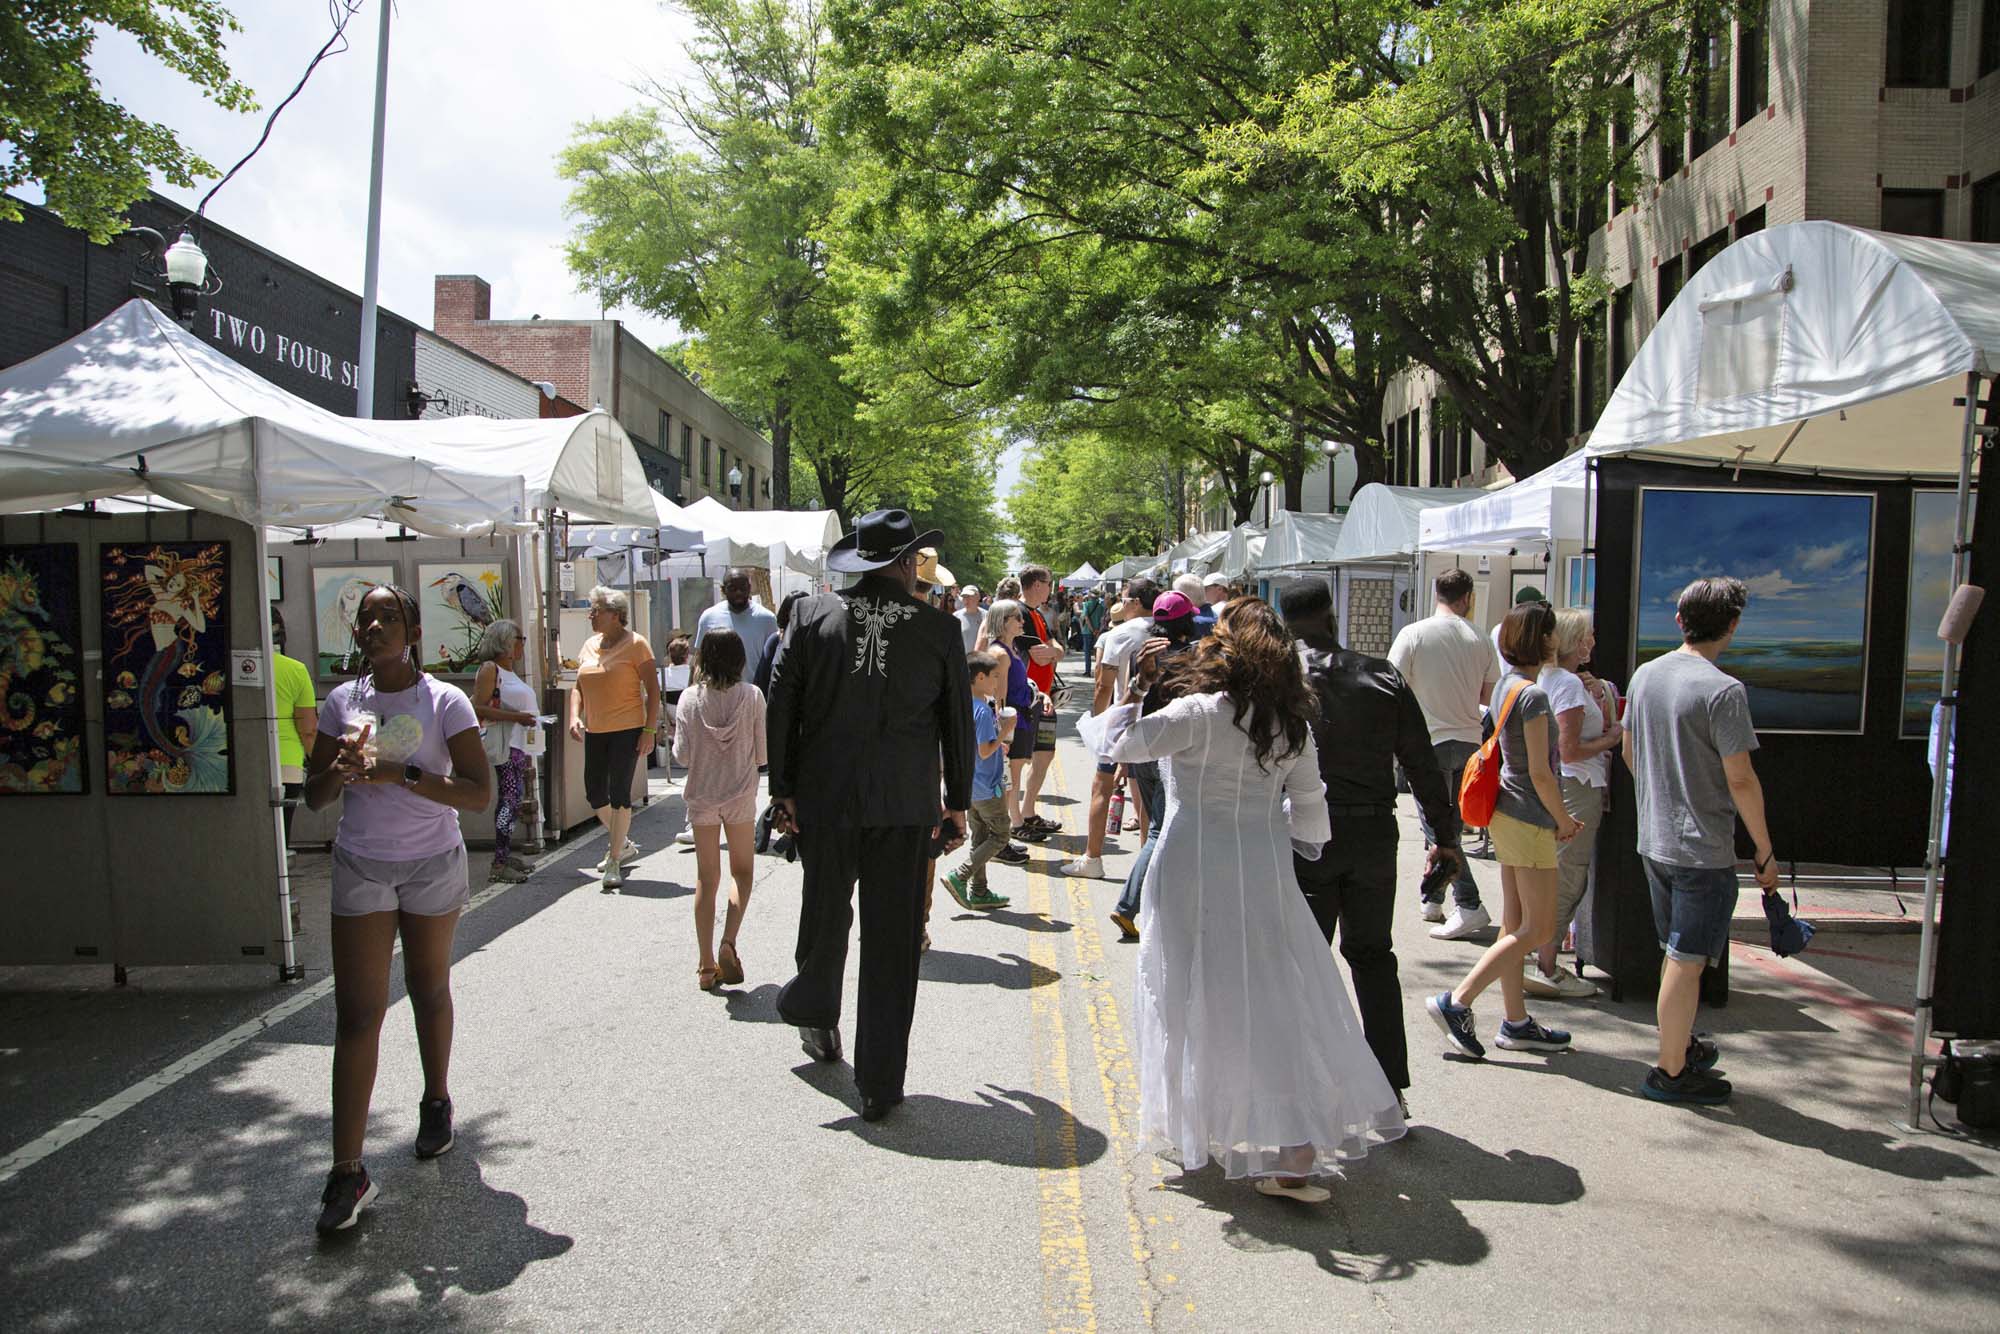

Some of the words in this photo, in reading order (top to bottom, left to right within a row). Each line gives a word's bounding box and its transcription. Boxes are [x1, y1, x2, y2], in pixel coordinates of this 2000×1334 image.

[210, 308, 266, 354] TWO
[276, 334, 333, 381] FOUR
[341, 360, 360, 390] SI
[434, 389, 470, 416] OLIVE
